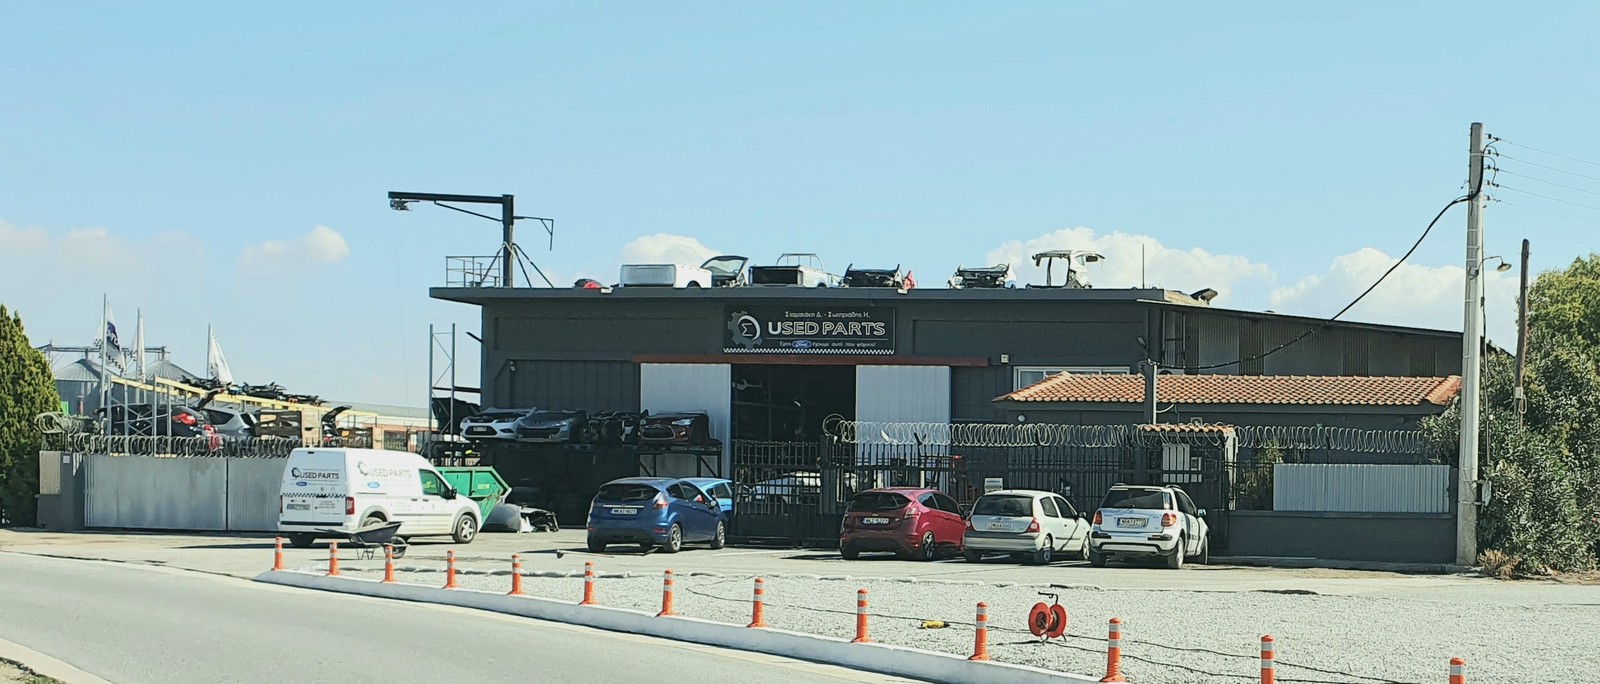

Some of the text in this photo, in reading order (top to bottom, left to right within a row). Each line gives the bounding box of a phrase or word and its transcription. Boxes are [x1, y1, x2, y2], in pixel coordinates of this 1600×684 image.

[741, 323, 752, 336] Σ
[768, 322, 886, 336] USED PARTS
[368, 469, 412, 478] USED PARTS
